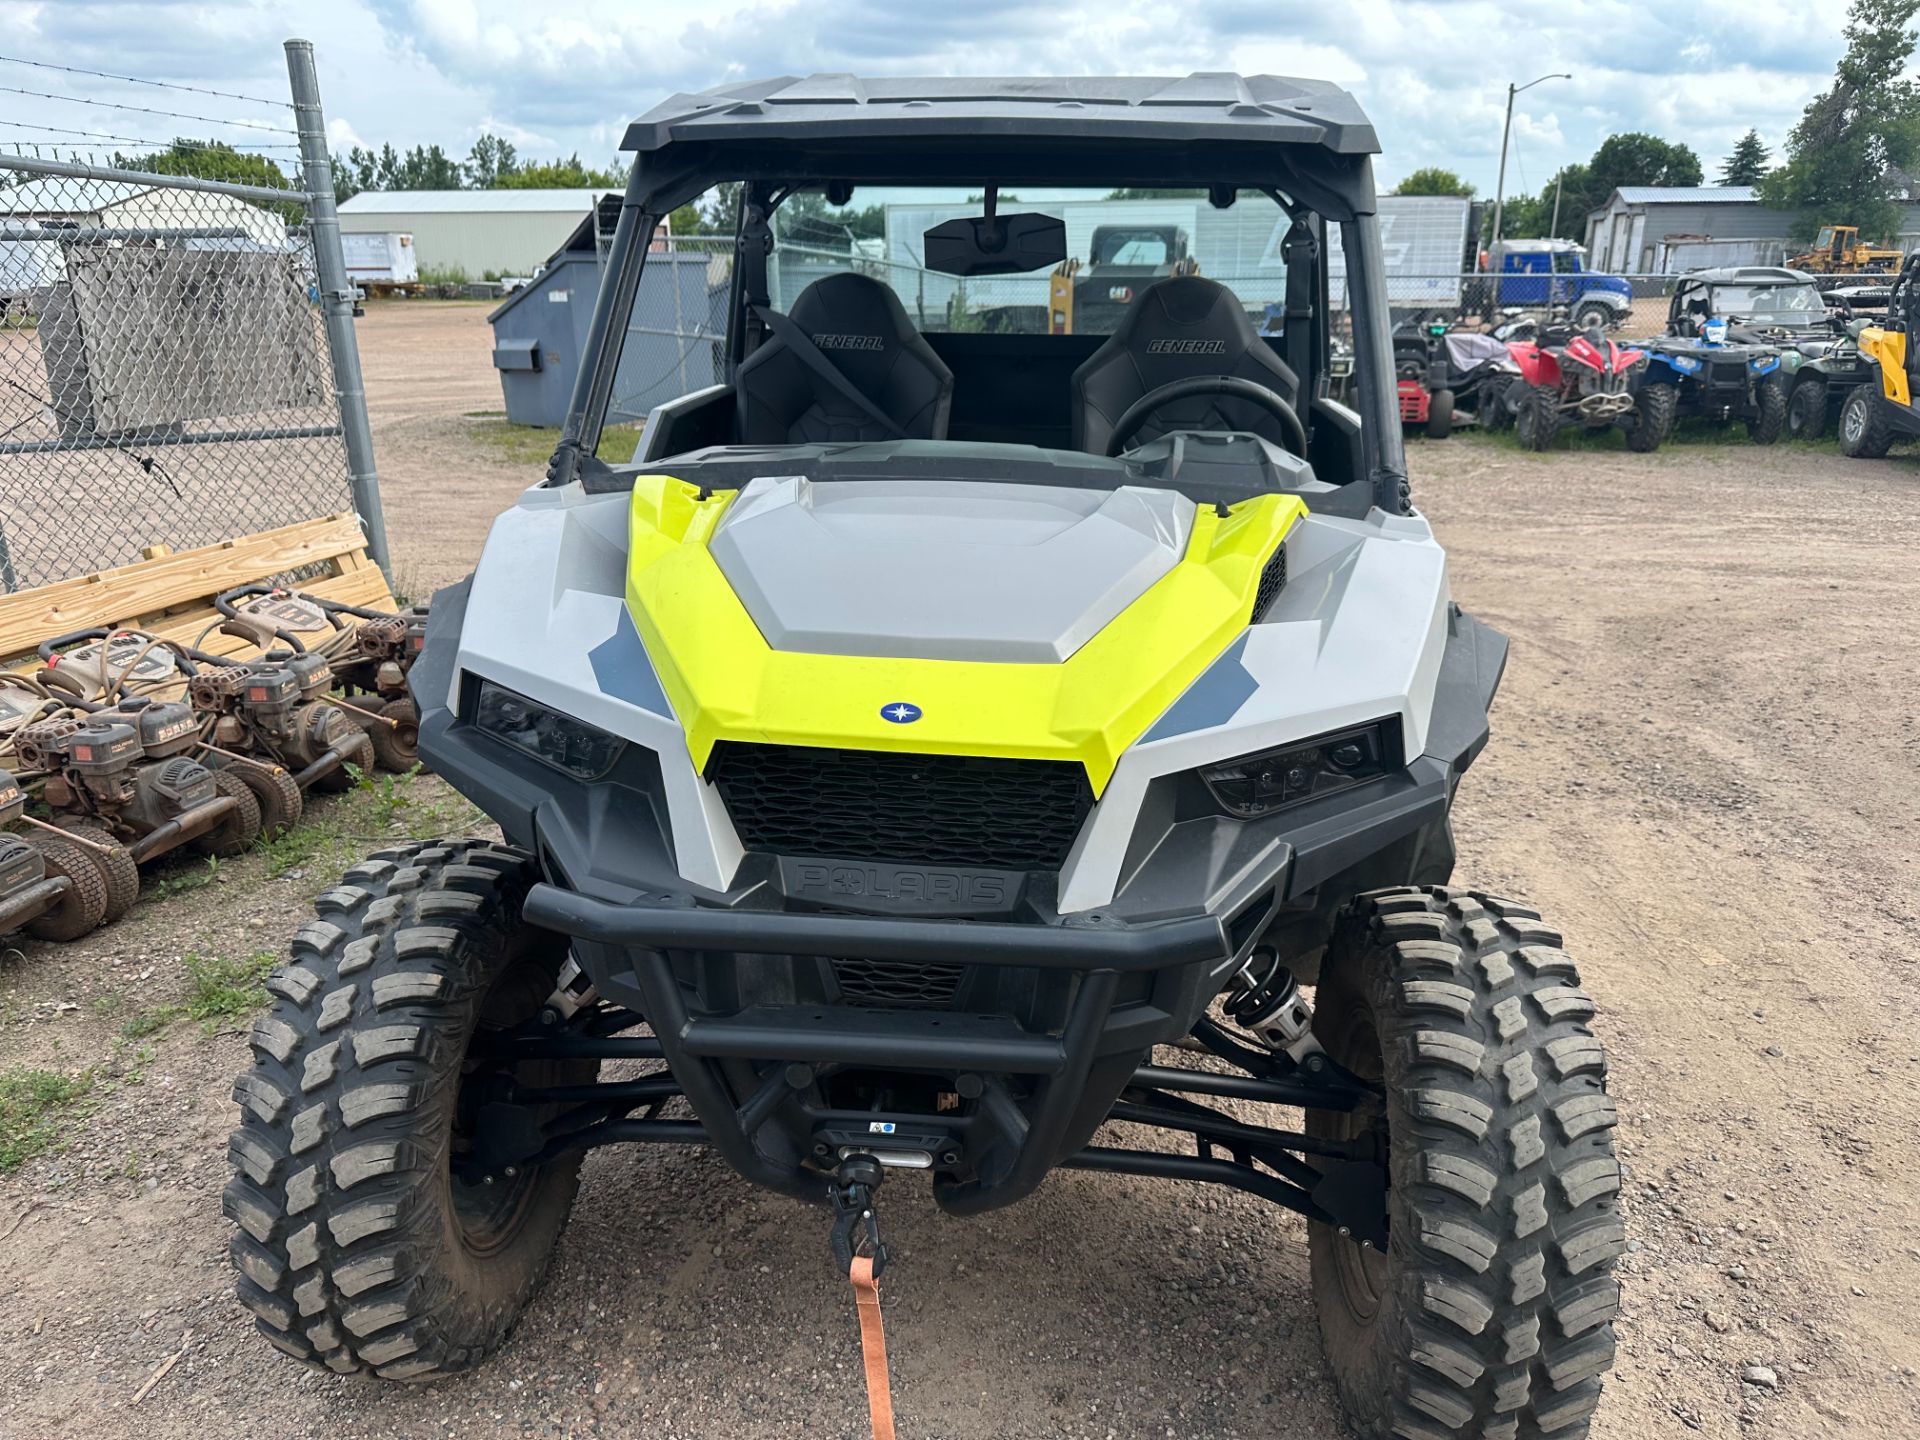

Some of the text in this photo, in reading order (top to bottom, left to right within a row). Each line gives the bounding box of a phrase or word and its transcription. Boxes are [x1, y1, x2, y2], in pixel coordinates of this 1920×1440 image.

[811, 333, 884, 351] GENERAL
[1146, 339, 1226, 354] GENERAL
[796, 864, 1006, 906] POLARIS
